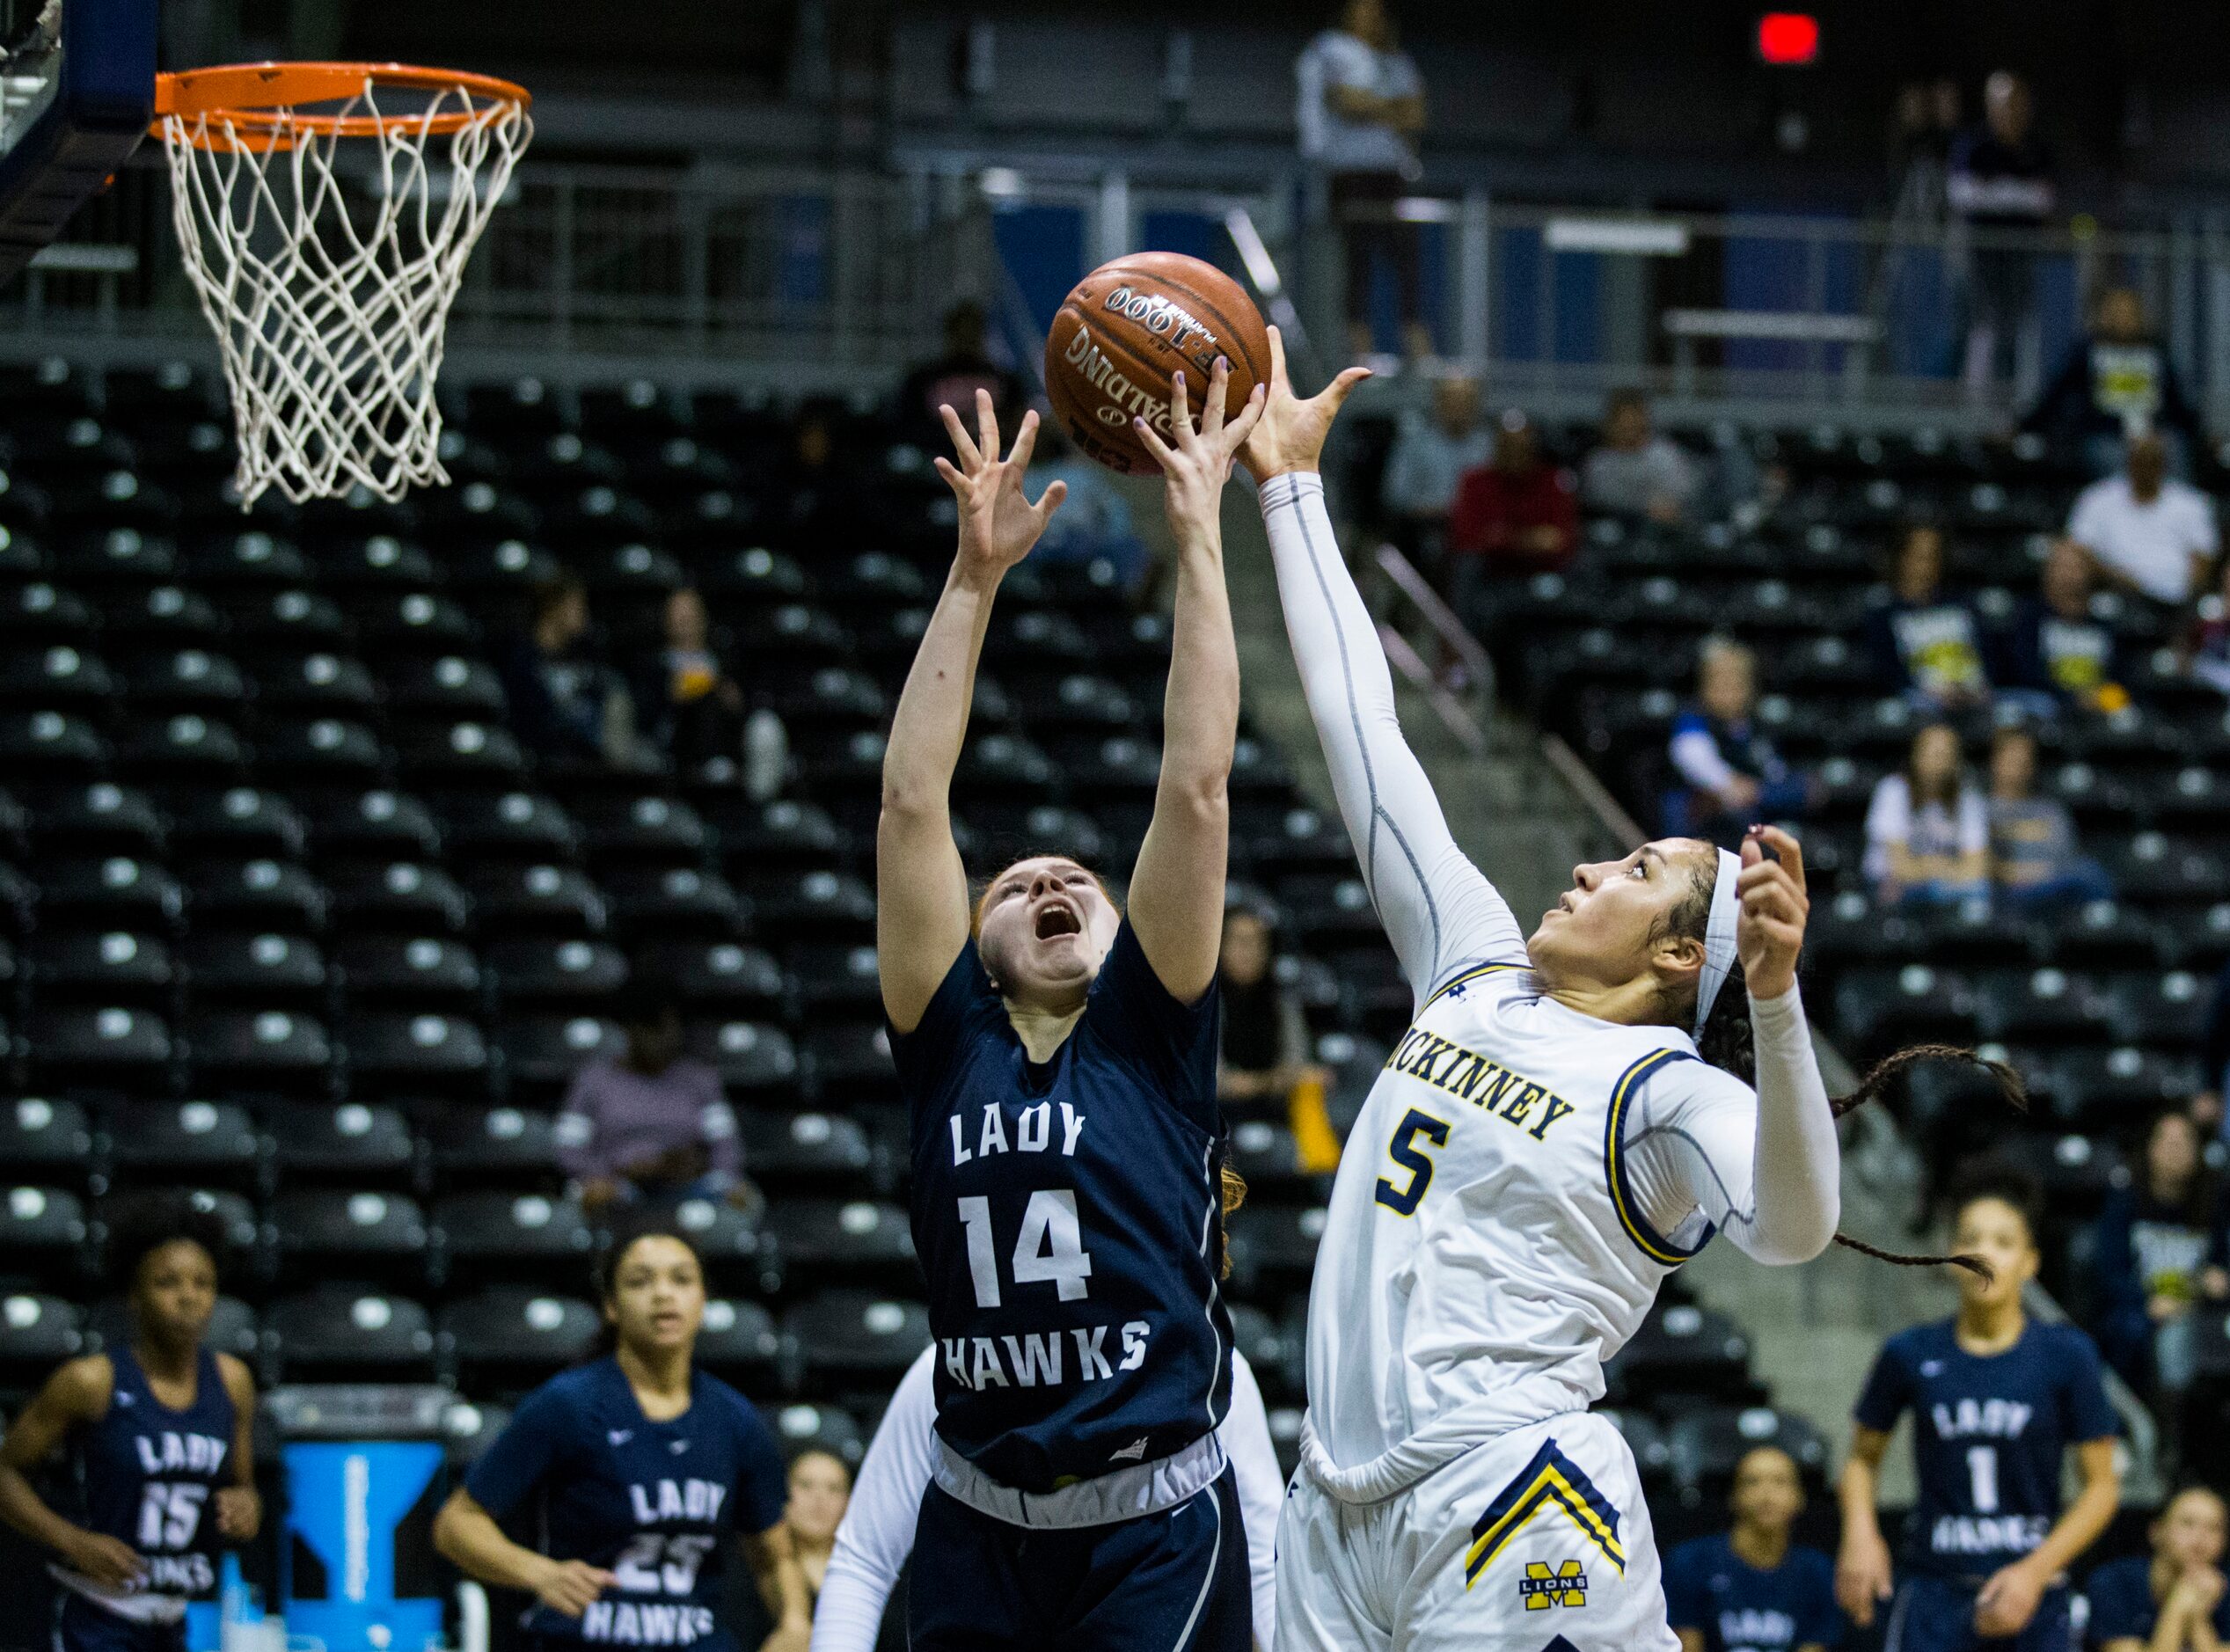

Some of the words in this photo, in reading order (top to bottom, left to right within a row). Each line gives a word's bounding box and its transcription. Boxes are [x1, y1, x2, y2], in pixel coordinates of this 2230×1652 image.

[951, 1101, 1086, 1166] LADY
[1375, 1107, 1451, 1217] 5
[957, 1189, 1092, 1308] 14
[941, 1320, 1151, 1391] HAWKS
[135, 1431, 227, 1475] LADY
[1966, 1445, 1999, 1513] 1
[138, 1480, 209, 1549] 15
[630, 1478, 727, 1524] LADY
[615, 1533, 715, 1596] 25
[1522, 1577, 1587, 1592] LIONS
[1525, 1559, 1586, 1611] M
[581, 1600, 714, 1646] HAWKS
